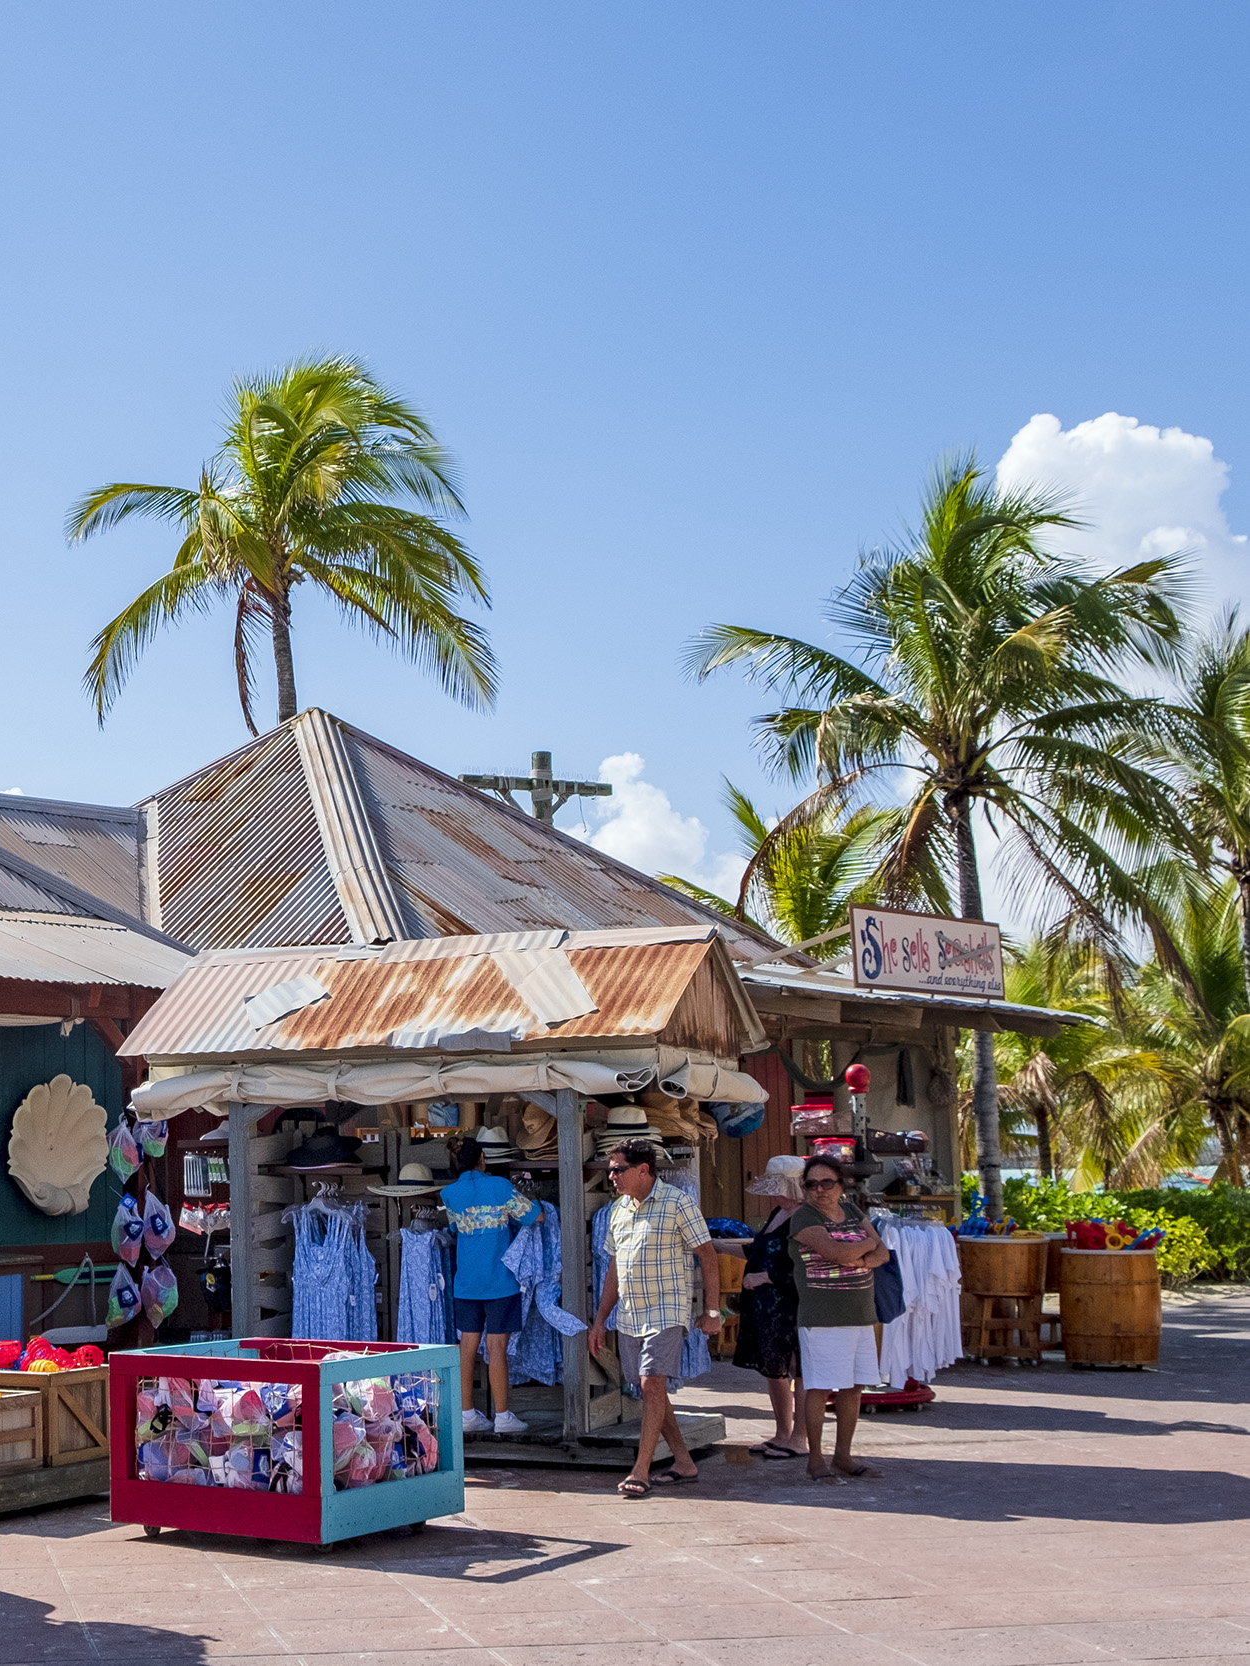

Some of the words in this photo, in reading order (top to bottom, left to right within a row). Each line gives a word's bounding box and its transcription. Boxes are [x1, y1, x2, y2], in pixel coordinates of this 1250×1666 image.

[860, 915, 898, 980] She
[944, 974, 985, 993] everything
[987, 976, 1001, 991] else
